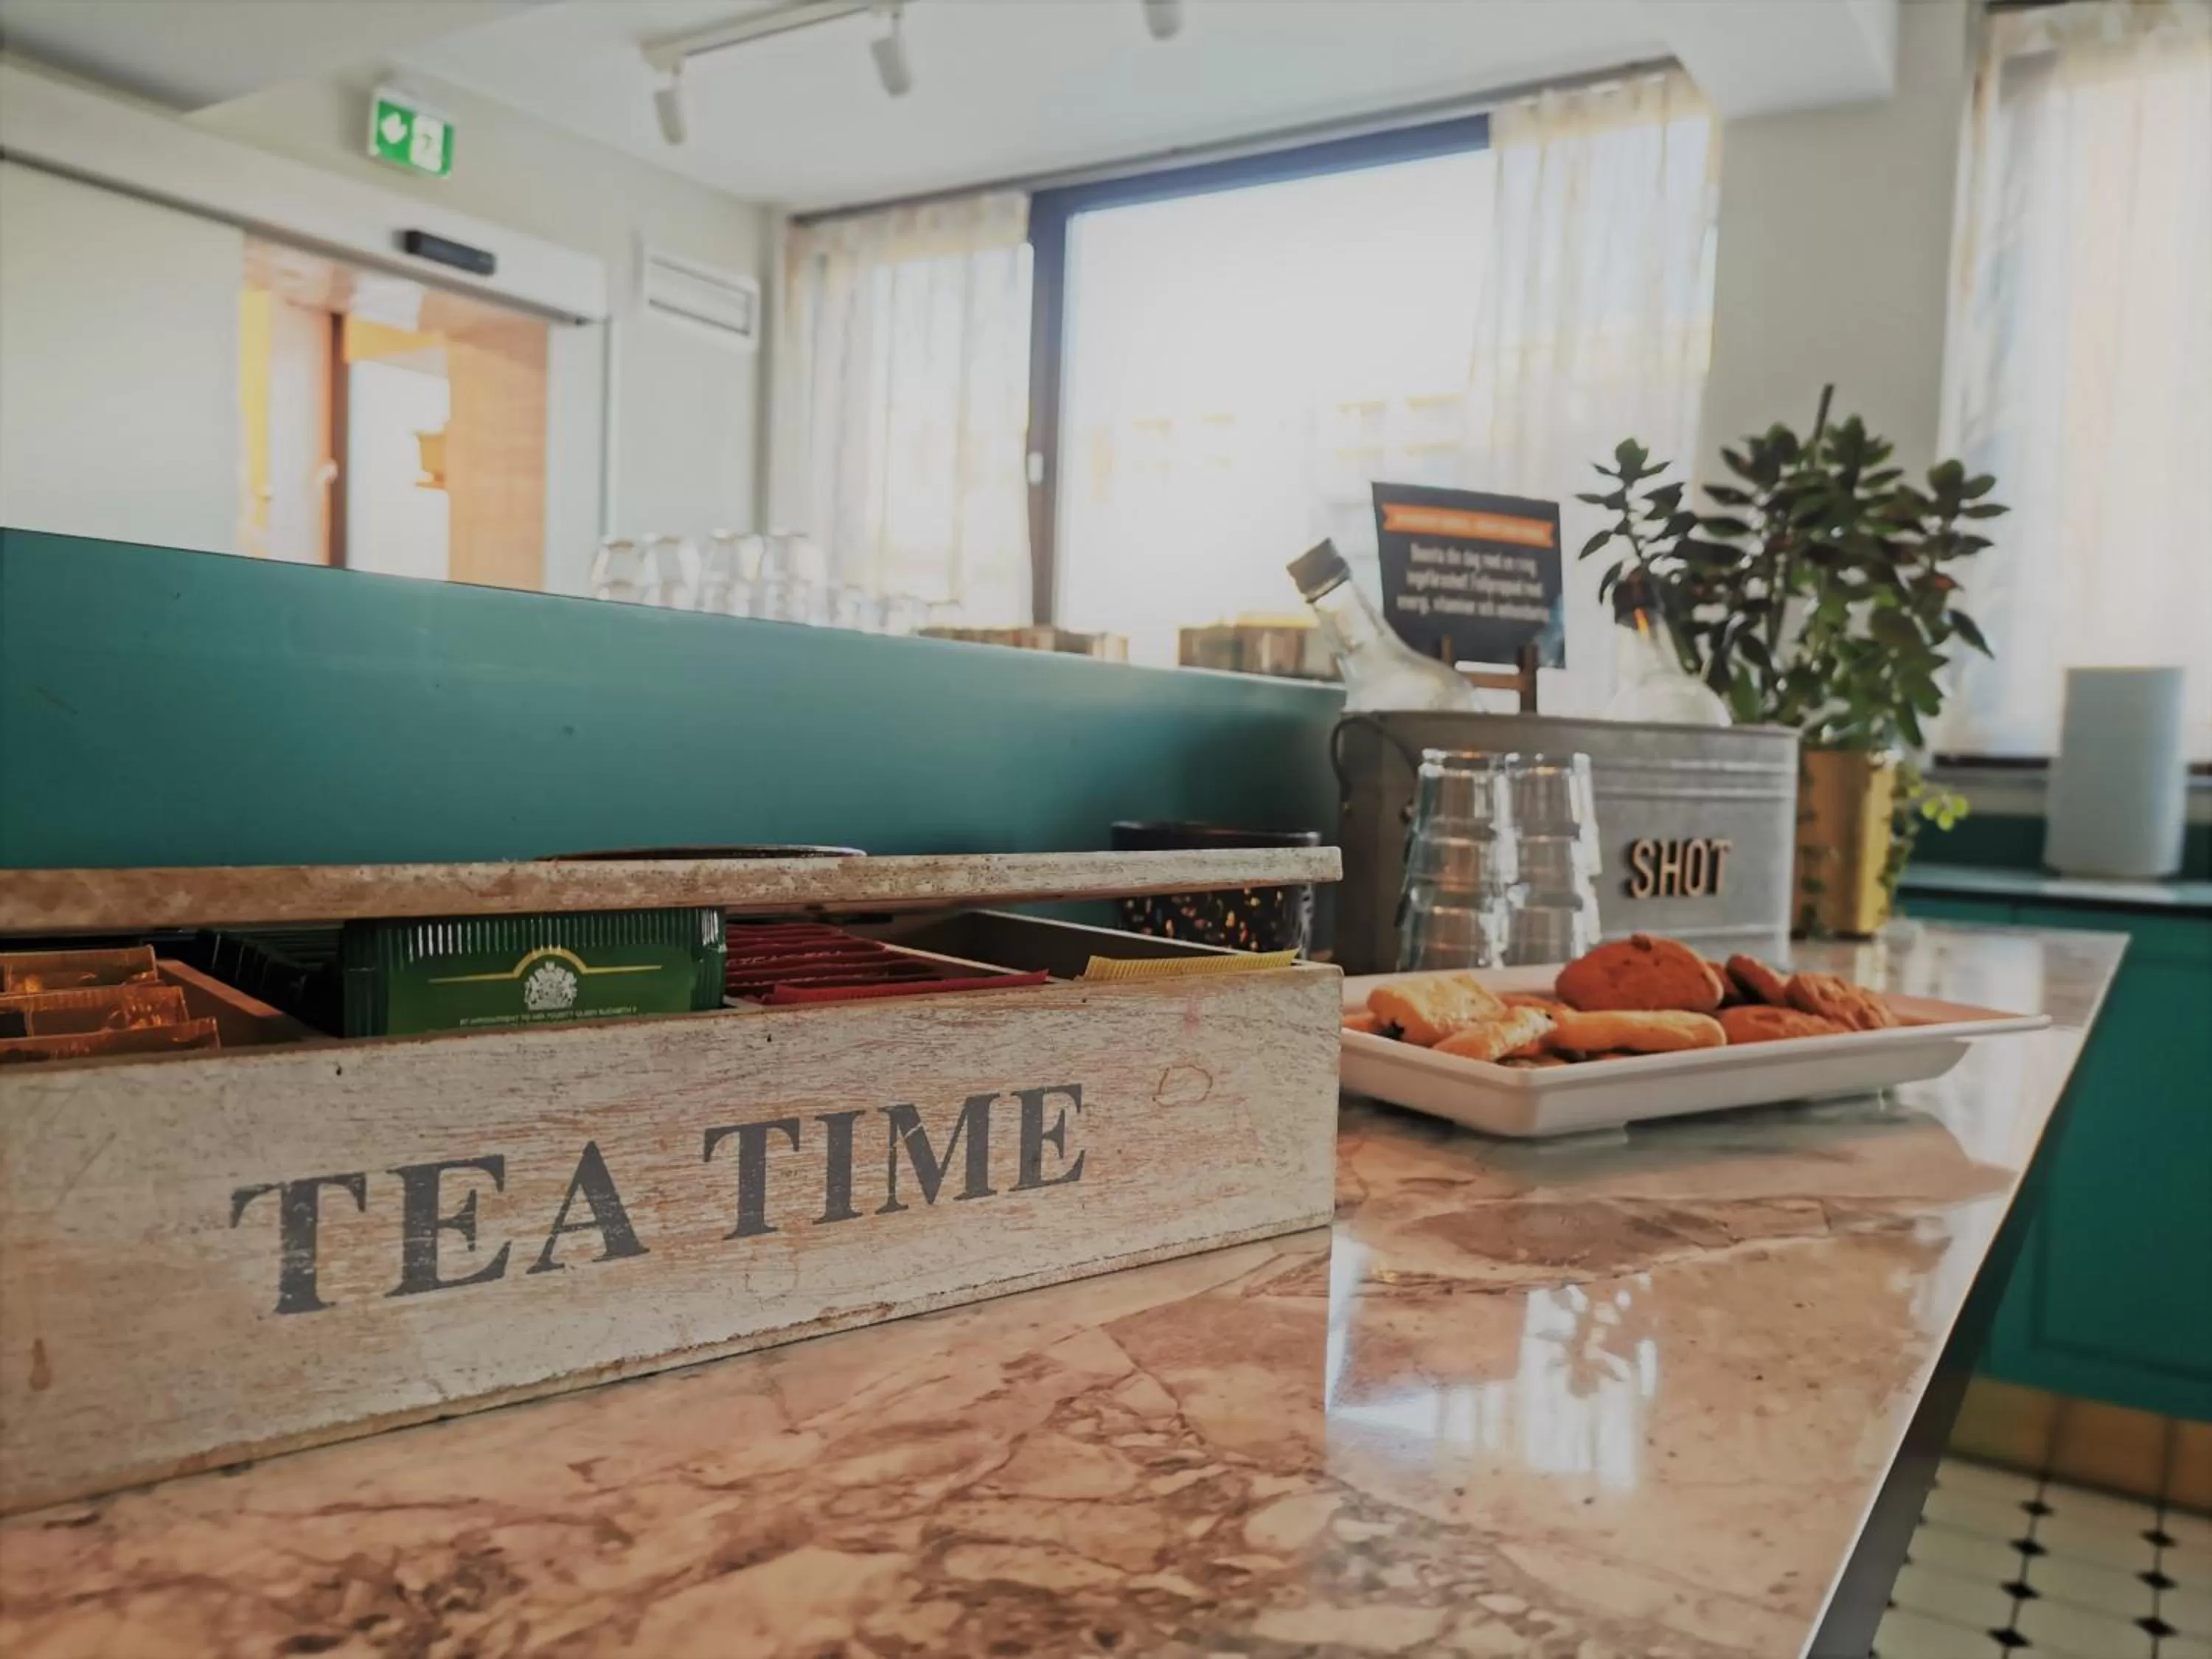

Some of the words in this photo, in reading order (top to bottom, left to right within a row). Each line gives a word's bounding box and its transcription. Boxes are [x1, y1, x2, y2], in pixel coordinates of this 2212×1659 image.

[1627, 838, 1733, 898] SHOT
[230, 1141, 650, 1315] TEA
[703, 1083, 1087, 1241] TIME
